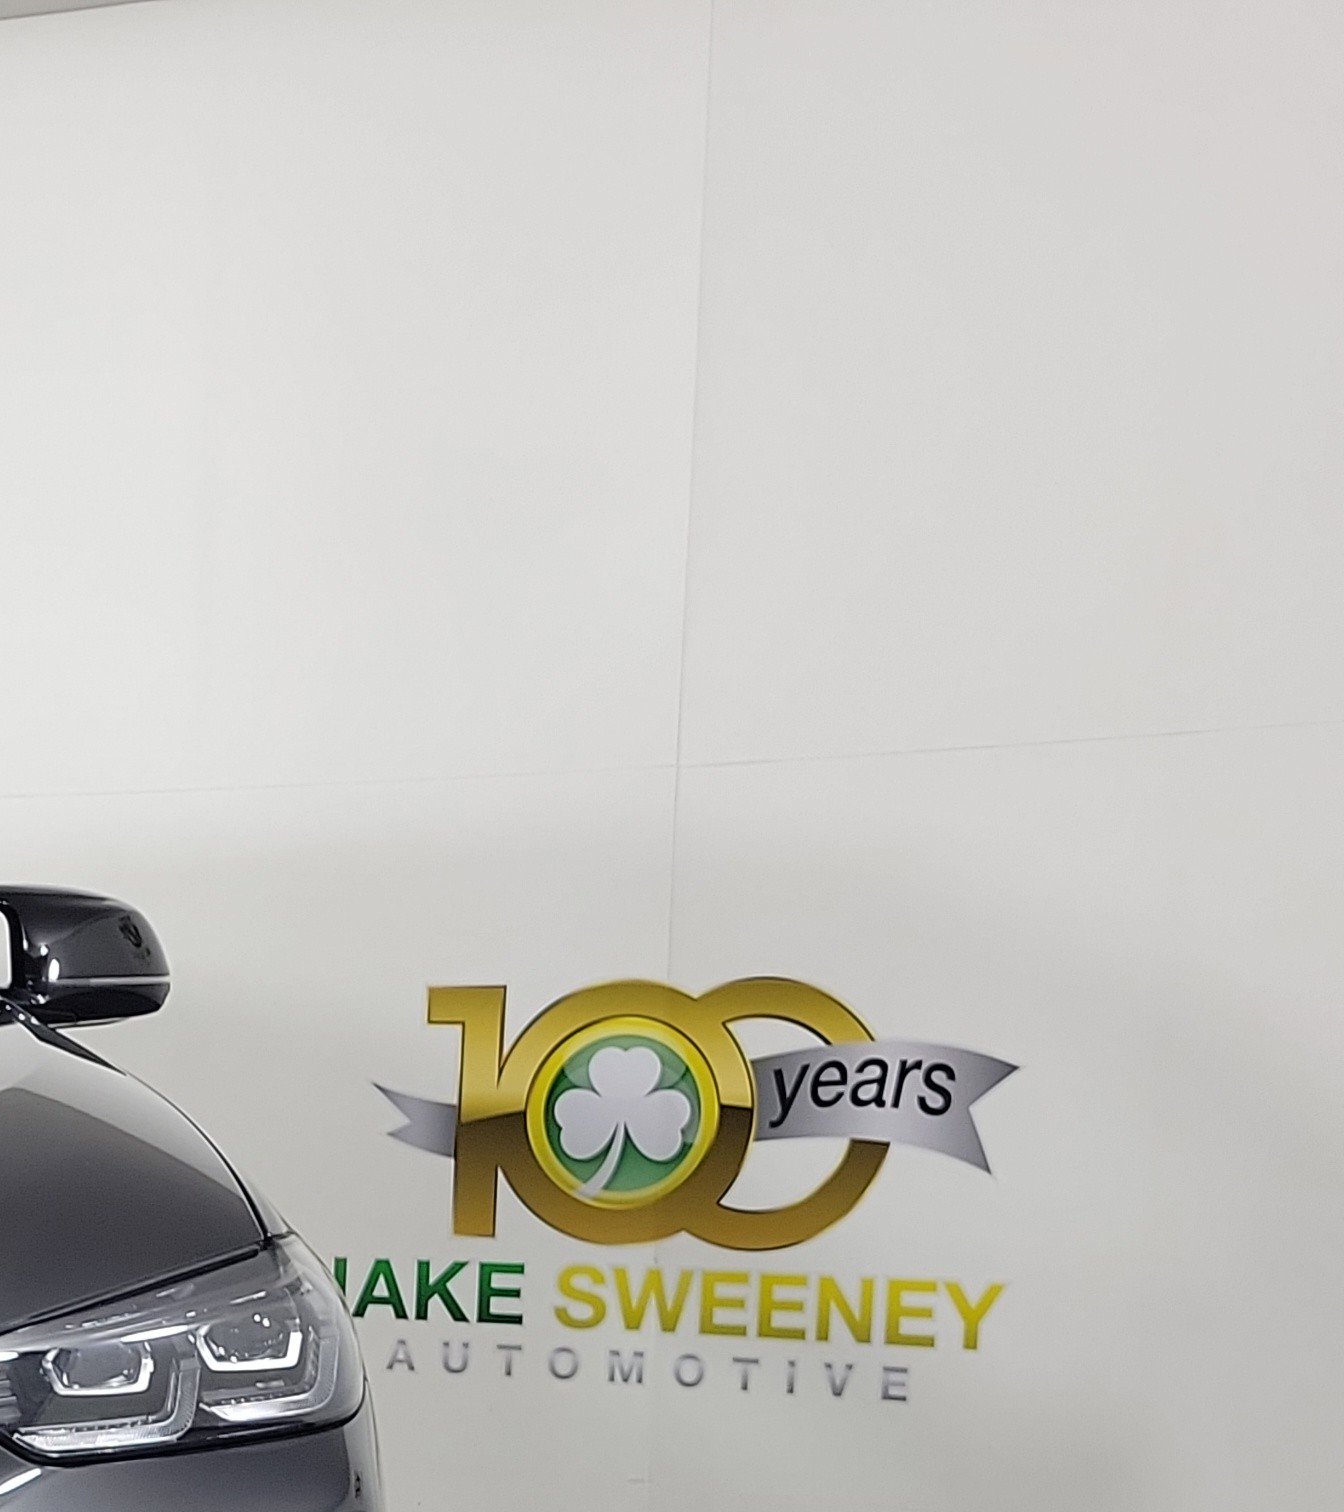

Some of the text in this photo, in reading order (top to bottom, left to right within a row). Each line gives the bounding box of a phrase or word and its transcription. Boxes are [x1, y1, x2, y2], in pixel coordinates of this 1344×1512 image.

[427, 976, 957, 1251] 100 years
[553, 1264, 1004, 1350] SWEENEY
[387, 1339, 910, 1402] AUTOMOTIVE
